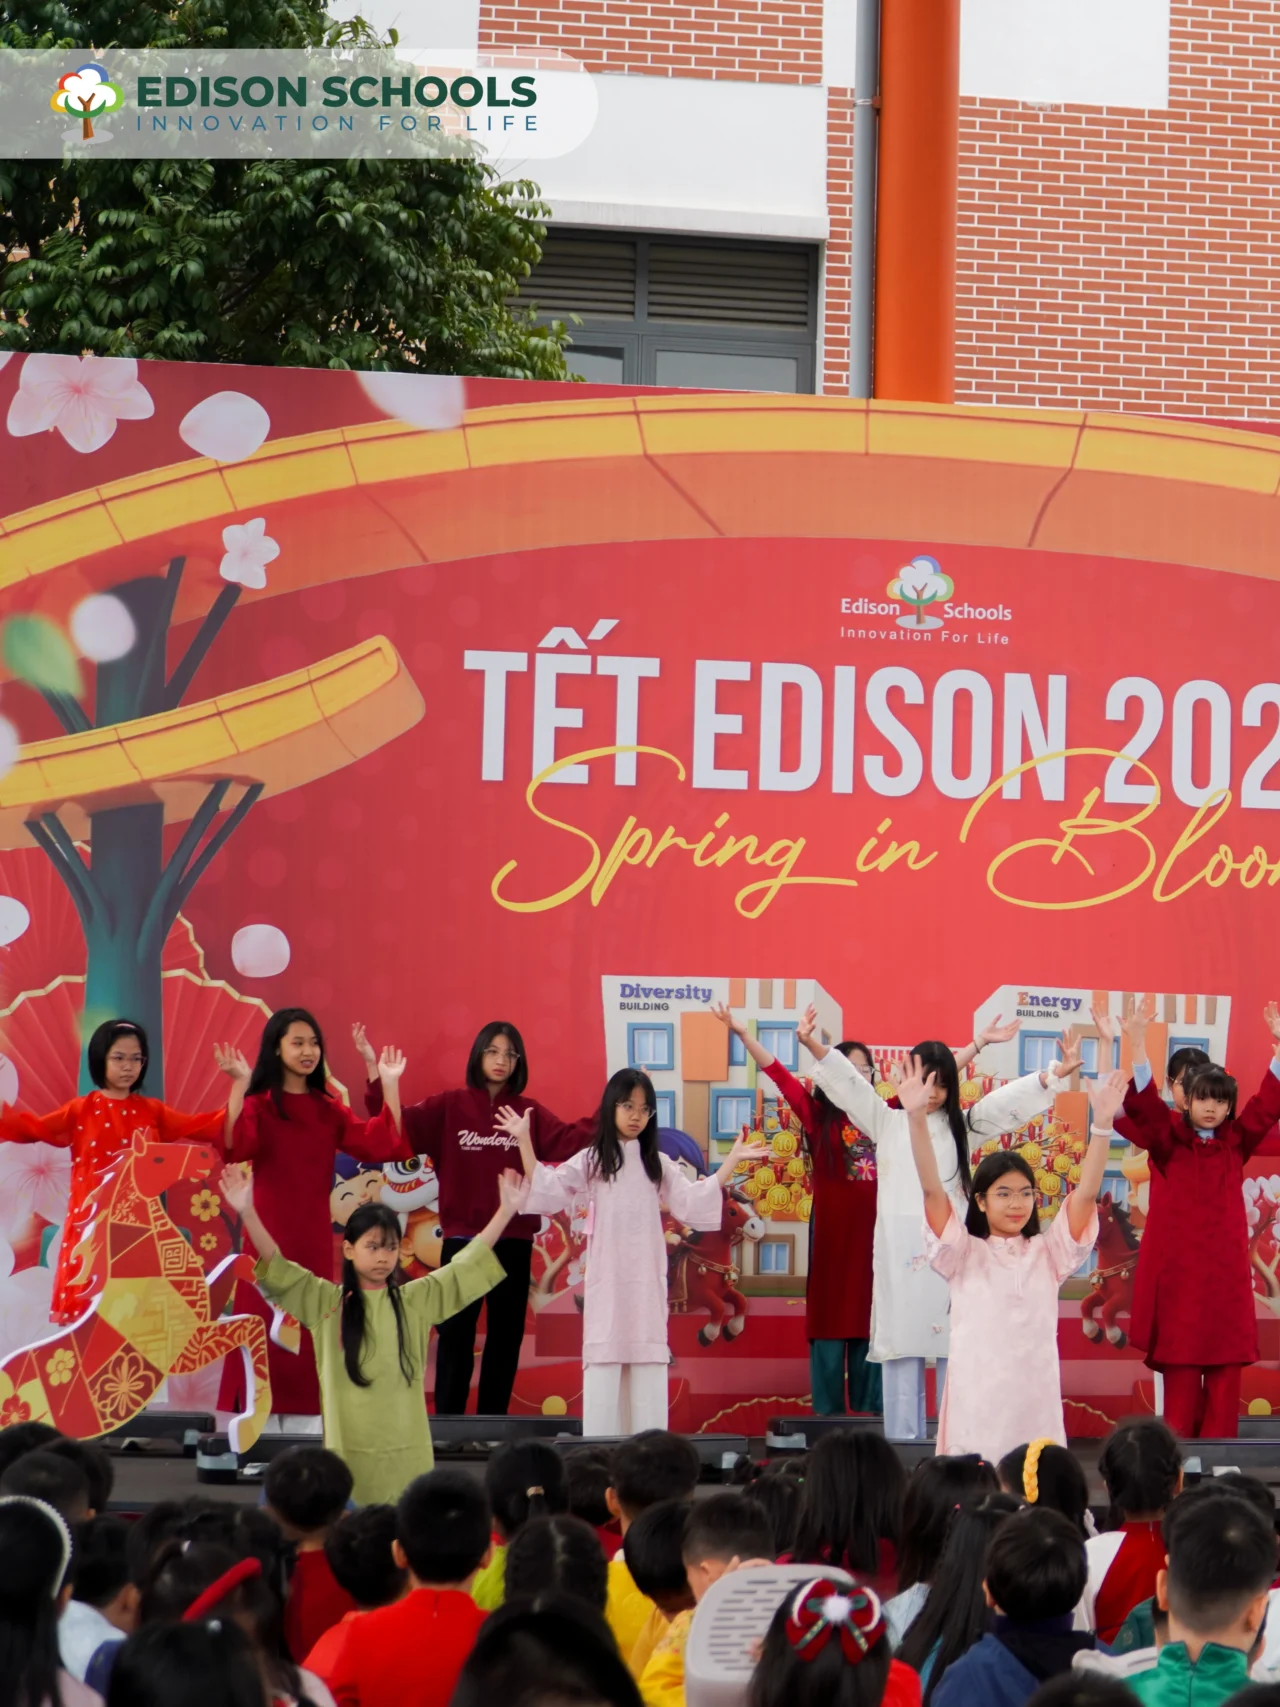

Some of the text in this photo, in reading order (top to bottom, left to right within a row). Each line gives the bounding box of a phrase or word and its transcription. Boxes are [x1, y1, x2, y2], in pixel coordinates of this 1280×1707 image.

[841, 597, 1012, 621] Edison Schools
[840, 626, 1009, 644] Innovation For Life
[463, 619, 660, 786] TẾT
[692, 659, 1067, 802] EDISON
[491, 745, 858, 919] Spring
[856, 817, 938, 873] in
[620, 983, 712, 1003] Diversity
[1017, 992, 1082, 1012] Energy
[619, 1002, 669, 1011] BUILDING
[1016, 1009, 1059, 1018] BUILDING
[457, 1129, 520, 1151] Wonderfu
[778, 1139, 793, 1151] 10
[773, 1193, 788, 1205] 10
